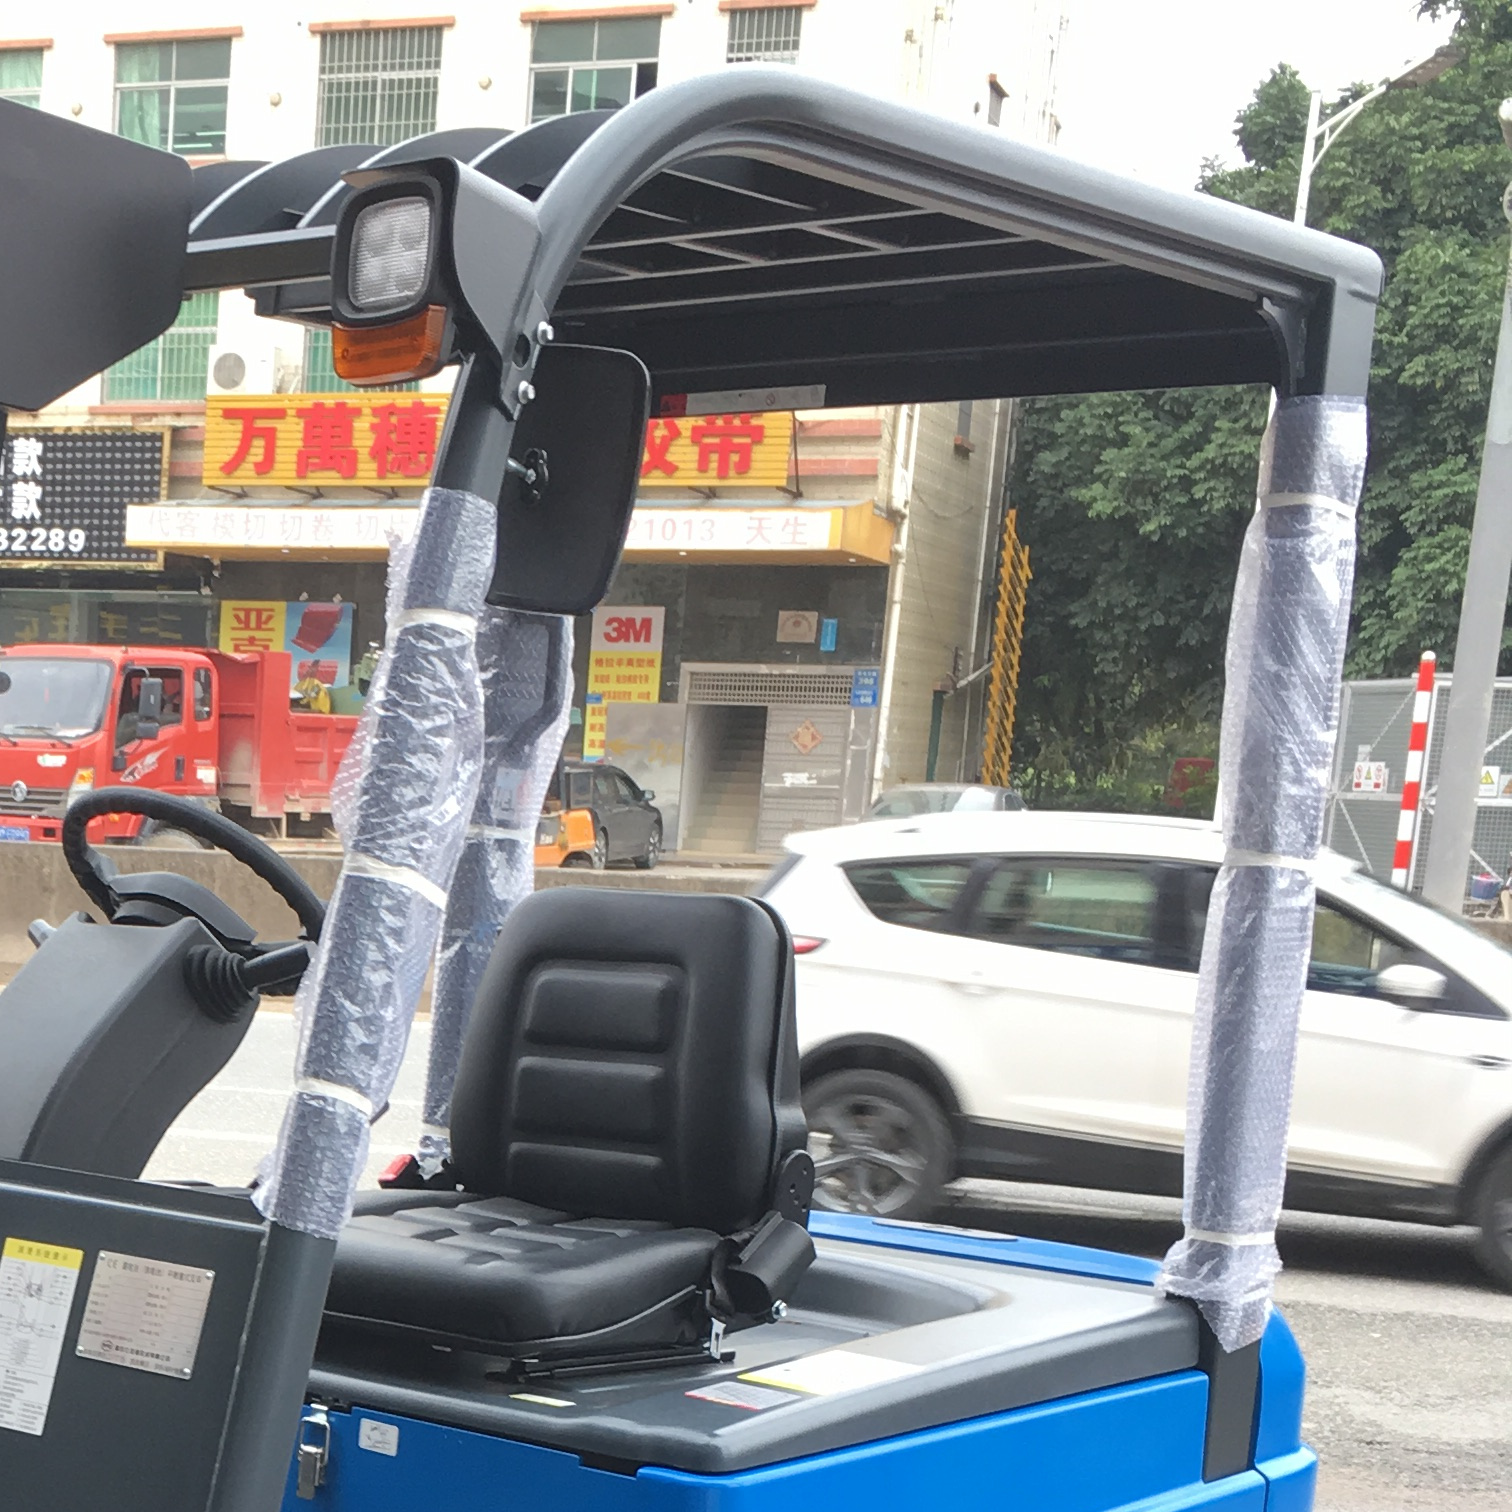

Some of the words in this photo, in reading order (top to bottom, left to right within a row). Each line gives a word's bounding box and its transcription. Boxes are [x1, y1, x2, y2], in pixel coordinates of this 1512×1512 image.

[0, 437, 44, 476] 款
[746, 515, 808, 546] 天生
[603, 617, 653, 643] 3M
